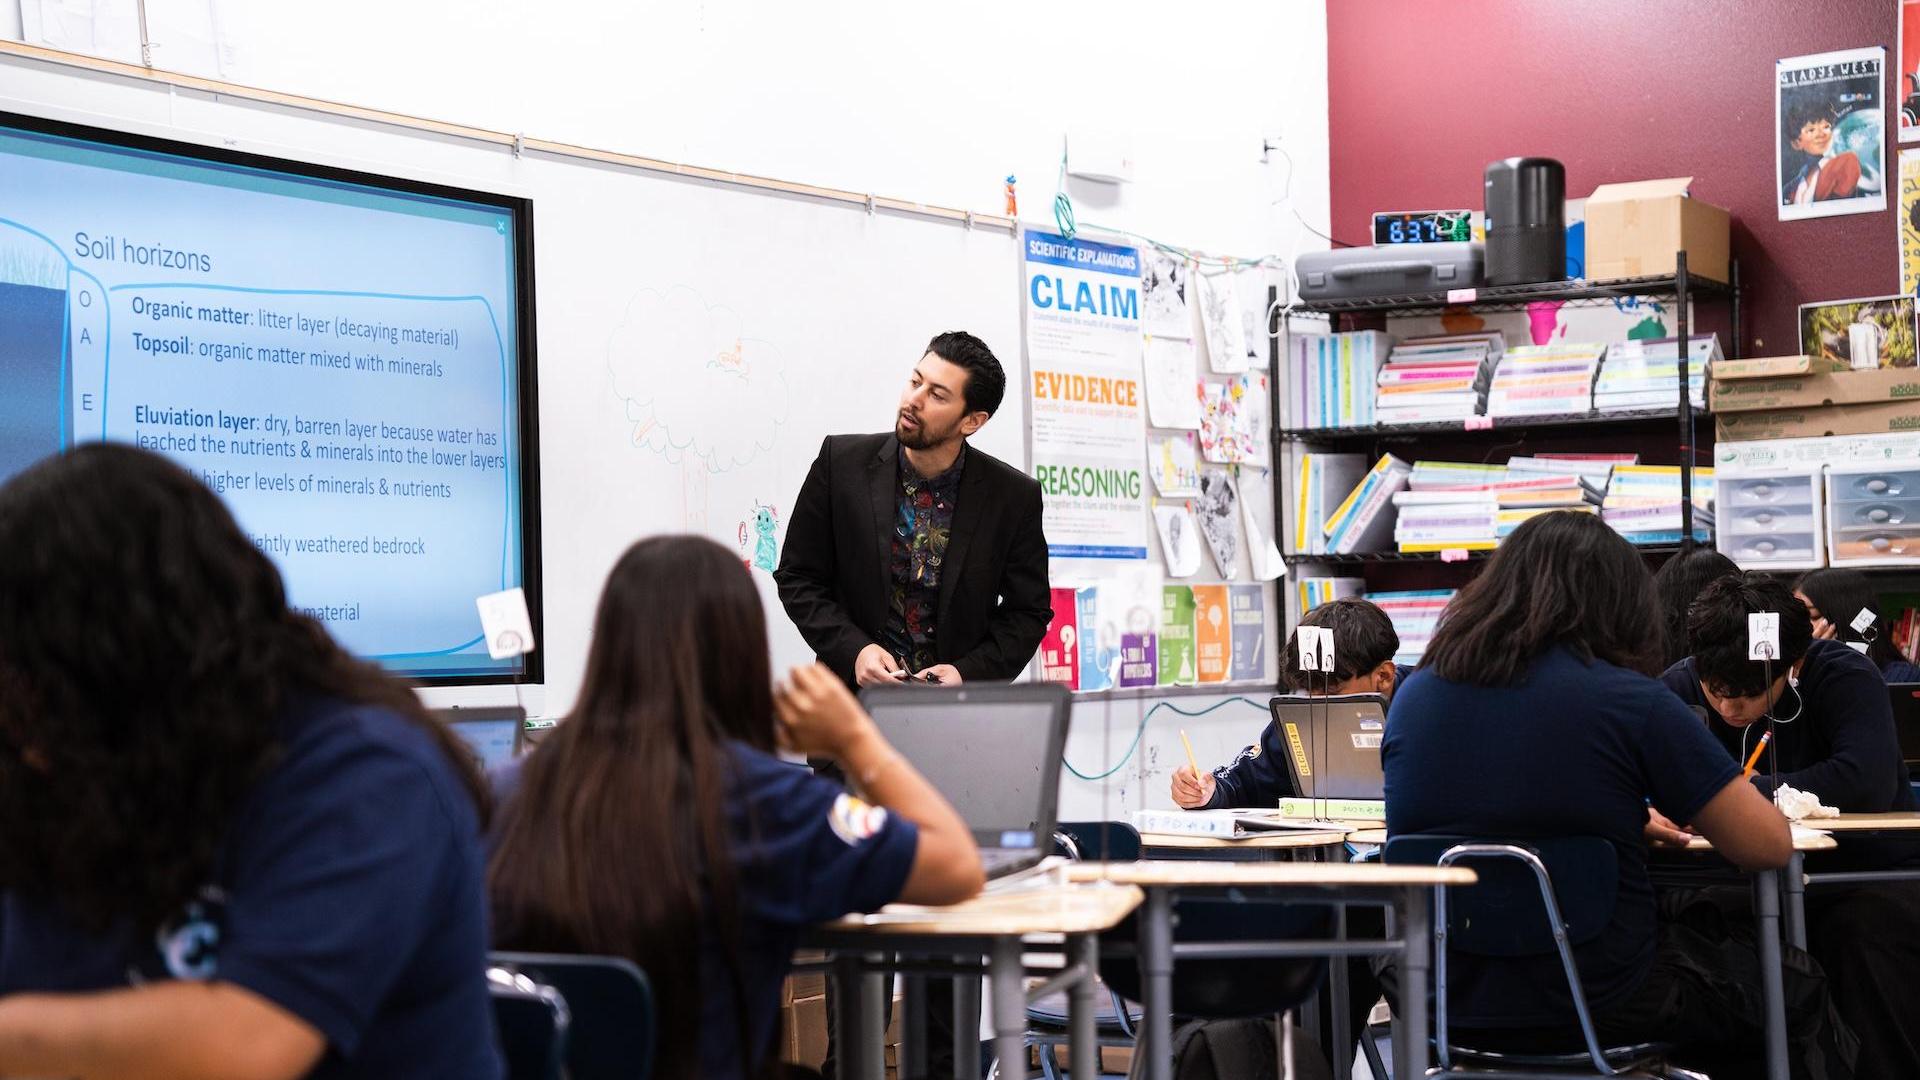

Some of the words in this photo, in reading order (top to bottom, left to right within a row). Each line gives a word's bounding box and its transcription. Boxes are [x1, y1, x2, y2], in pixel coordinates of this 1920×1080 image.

[1781, 65, 1835, 84] GLADYS
[1841, 60, 1880, 75] WEST
[75, 231, 115, 261] Soil
[123, 237, 211, 273] horizons
[1029, 239, 1077, 261] SCIENTIFIC
[1077, 247, 1137, 270] EXPLANATIONS
[79, 290, 92, 308] O
[1030, 273, 1138, 320] CLAIM
[80, 328, 92, 345] A
[132, 296, 193, 321] Organic
[198, 307, 254, 326] matter:
[258, 308, 293, 330] litter
[297, 312, 330, 337] layer
[334, 315, 399, 345] (decaying
[402, 327, 459, 350] material)
[132, 332, 194, 356] Topsoil:
[199, 341, 253, 362] organic
[257, 345, 305, 366] matter
[310, 349, 351, 370] mixed
[355, 353, 384, 373] with
[388, 357, 443, 378] minerals
[82, 393, 94, 411] E
[1034, 370, 1138, 407] EVIDENCE
[135, 405, 214, 428] Eluviation
[219, 410, 260, 434] layer:
[264, 413, 290, 436] dry,
[295, 414, 341, 436] barren
[345, 418, 377, 441] layer
[381, 421, 434, 442] because
[437, 428, 473, 444] water
[476, 428, 497, 446] has
[136, 430, 196, 451] leached
[200, 434, 226, 454] the
[230, 438, 296, 458] nutrients
[300, 440, 311, 458] &
[316, 441, 374, 462] minerals
[378, 445, 403, 463] into
[407, 447, 429, 465] the
[432, 447, 467, 466] lower
[470, 450, 505, 471] layers
[203, 469, 251, 493] higher
[255, 472, 295, 492] levels
[299, 474, 314, 492] of
[317, 476, 375, 495] minerals
[379, 478, 389, 495] &
[393, 479, 451, 498] nutrients
[1036, 464, 1141, 499] REASONING
[248, 533, 291, 557] lightly
[295, 534, 369, 554] weathered
[373, 536, 425, 555] bedrock
[303, 602, 360, 621] material
